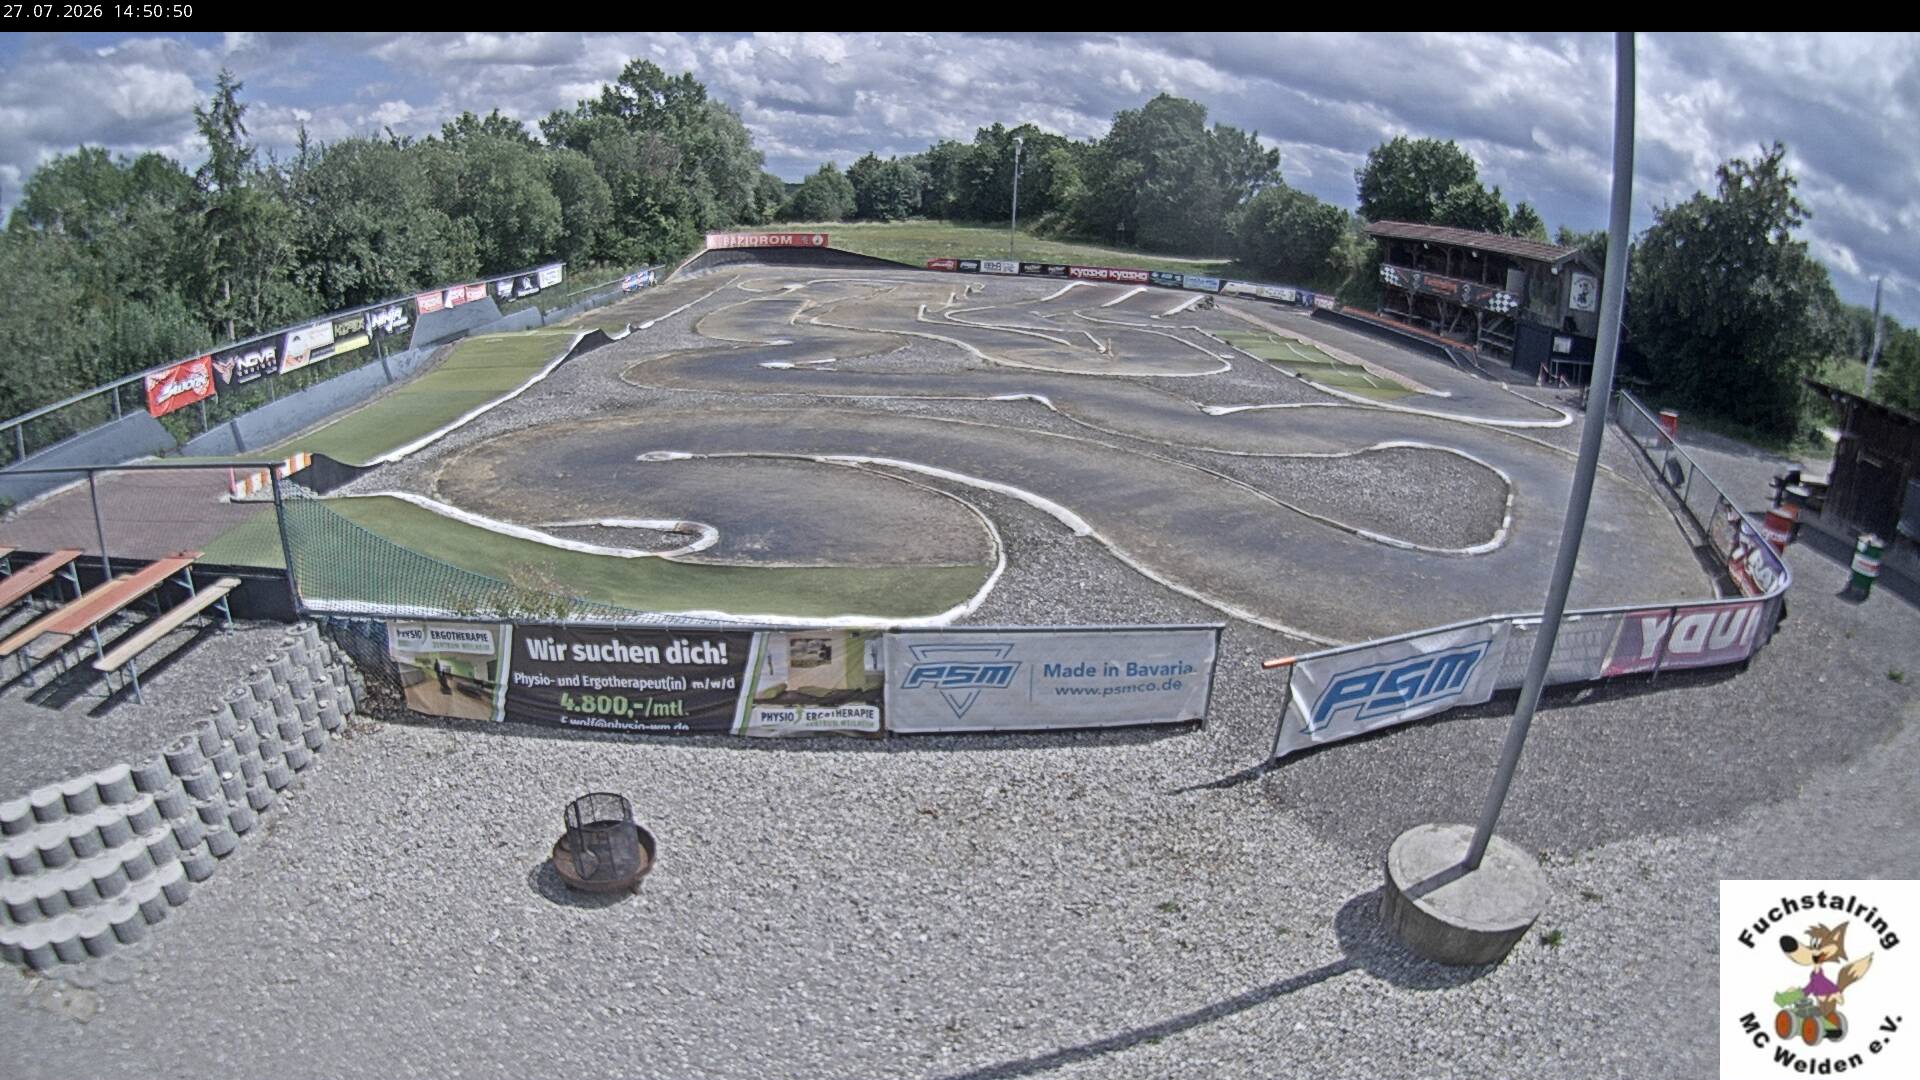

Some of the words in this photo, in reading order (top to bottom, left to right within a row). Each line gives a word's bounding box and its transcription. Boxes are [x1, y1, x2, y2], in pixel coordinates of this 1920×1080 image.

[1071, 267, 1108, 280] KYOSHO
[1110, 269, 1148, 281] KYOSHO
[236, 348, 277, 369] NOVA
[430, 630, 488, 642] ERGOTHERAPIE
[526, 637, 567, 662] Wir
[573, 640, 660, 664] suchen
[665, 640, 728, 665] dich!
[906, 664, 1015, 686] PSM
[1043, 664, 1096, 678] Made
[1104, 663, 1118, 677] in
[1126, 661, 1194, 677] Bavaria
[513, 672, 555, 688] Physio-
[558, 674, 580, 687] und
[583, 675, 687, 691] Ergotherapeut(in)
[692, 677, 736, 690] m/w/d
[1055, 679, 1183, 698] www.psmco.de
[1311, 646, 1484, 724] PSM
[560, 692, 690, 718] 4.800,-/mtl.
[761, 711, 794, 722] PHYSIO
